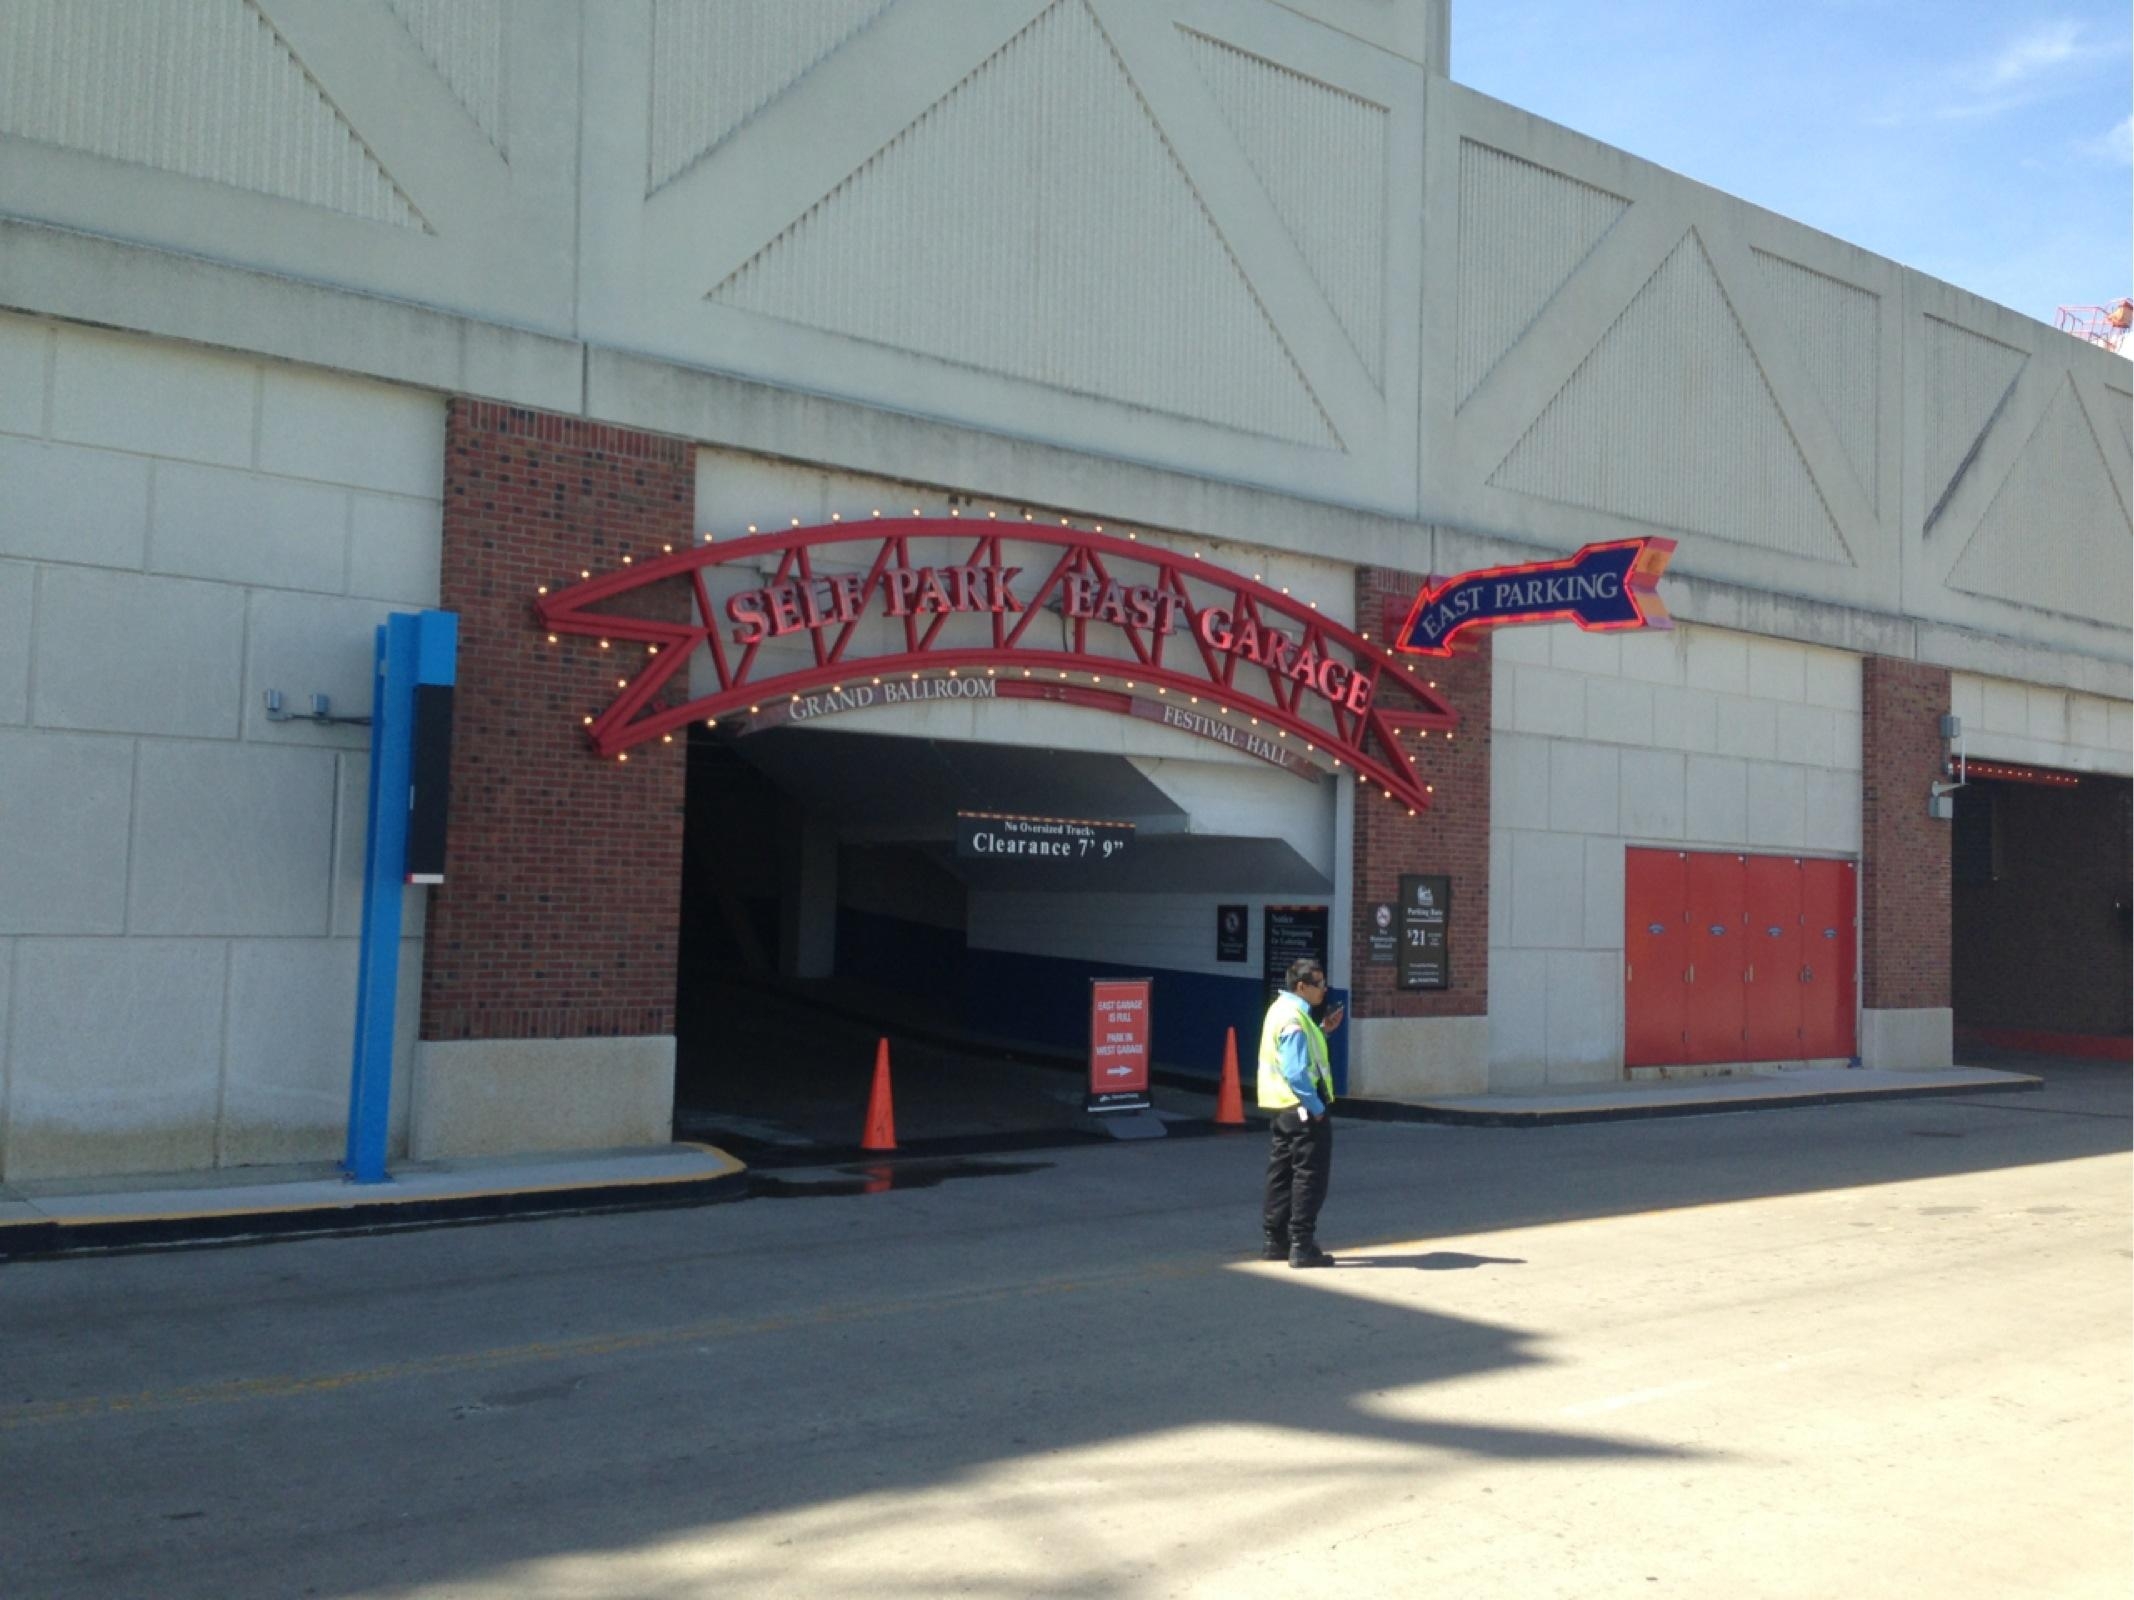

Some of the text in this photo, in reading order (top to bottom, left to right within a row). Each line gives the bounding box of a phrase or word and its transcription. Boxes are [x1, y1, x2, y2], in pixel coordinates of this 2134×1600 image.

[1421, 572, 1619, 641] EAST PARKING
[726, 566, 1372, 716] SELF PARK EAST GARAGE
[788, 677, 997, 721] GRAND BALLROOM
[1163, 704, 1289, 767] FESTIVAL HALL
[972, 832, 1071, 856] Clearance
[1004, 821, 1096, 836] No Oversized Trucks
[1097, 1000, 1143, 1011] EAST GARAGE
[1116, 1043, 1144, 1055] GARAGE
